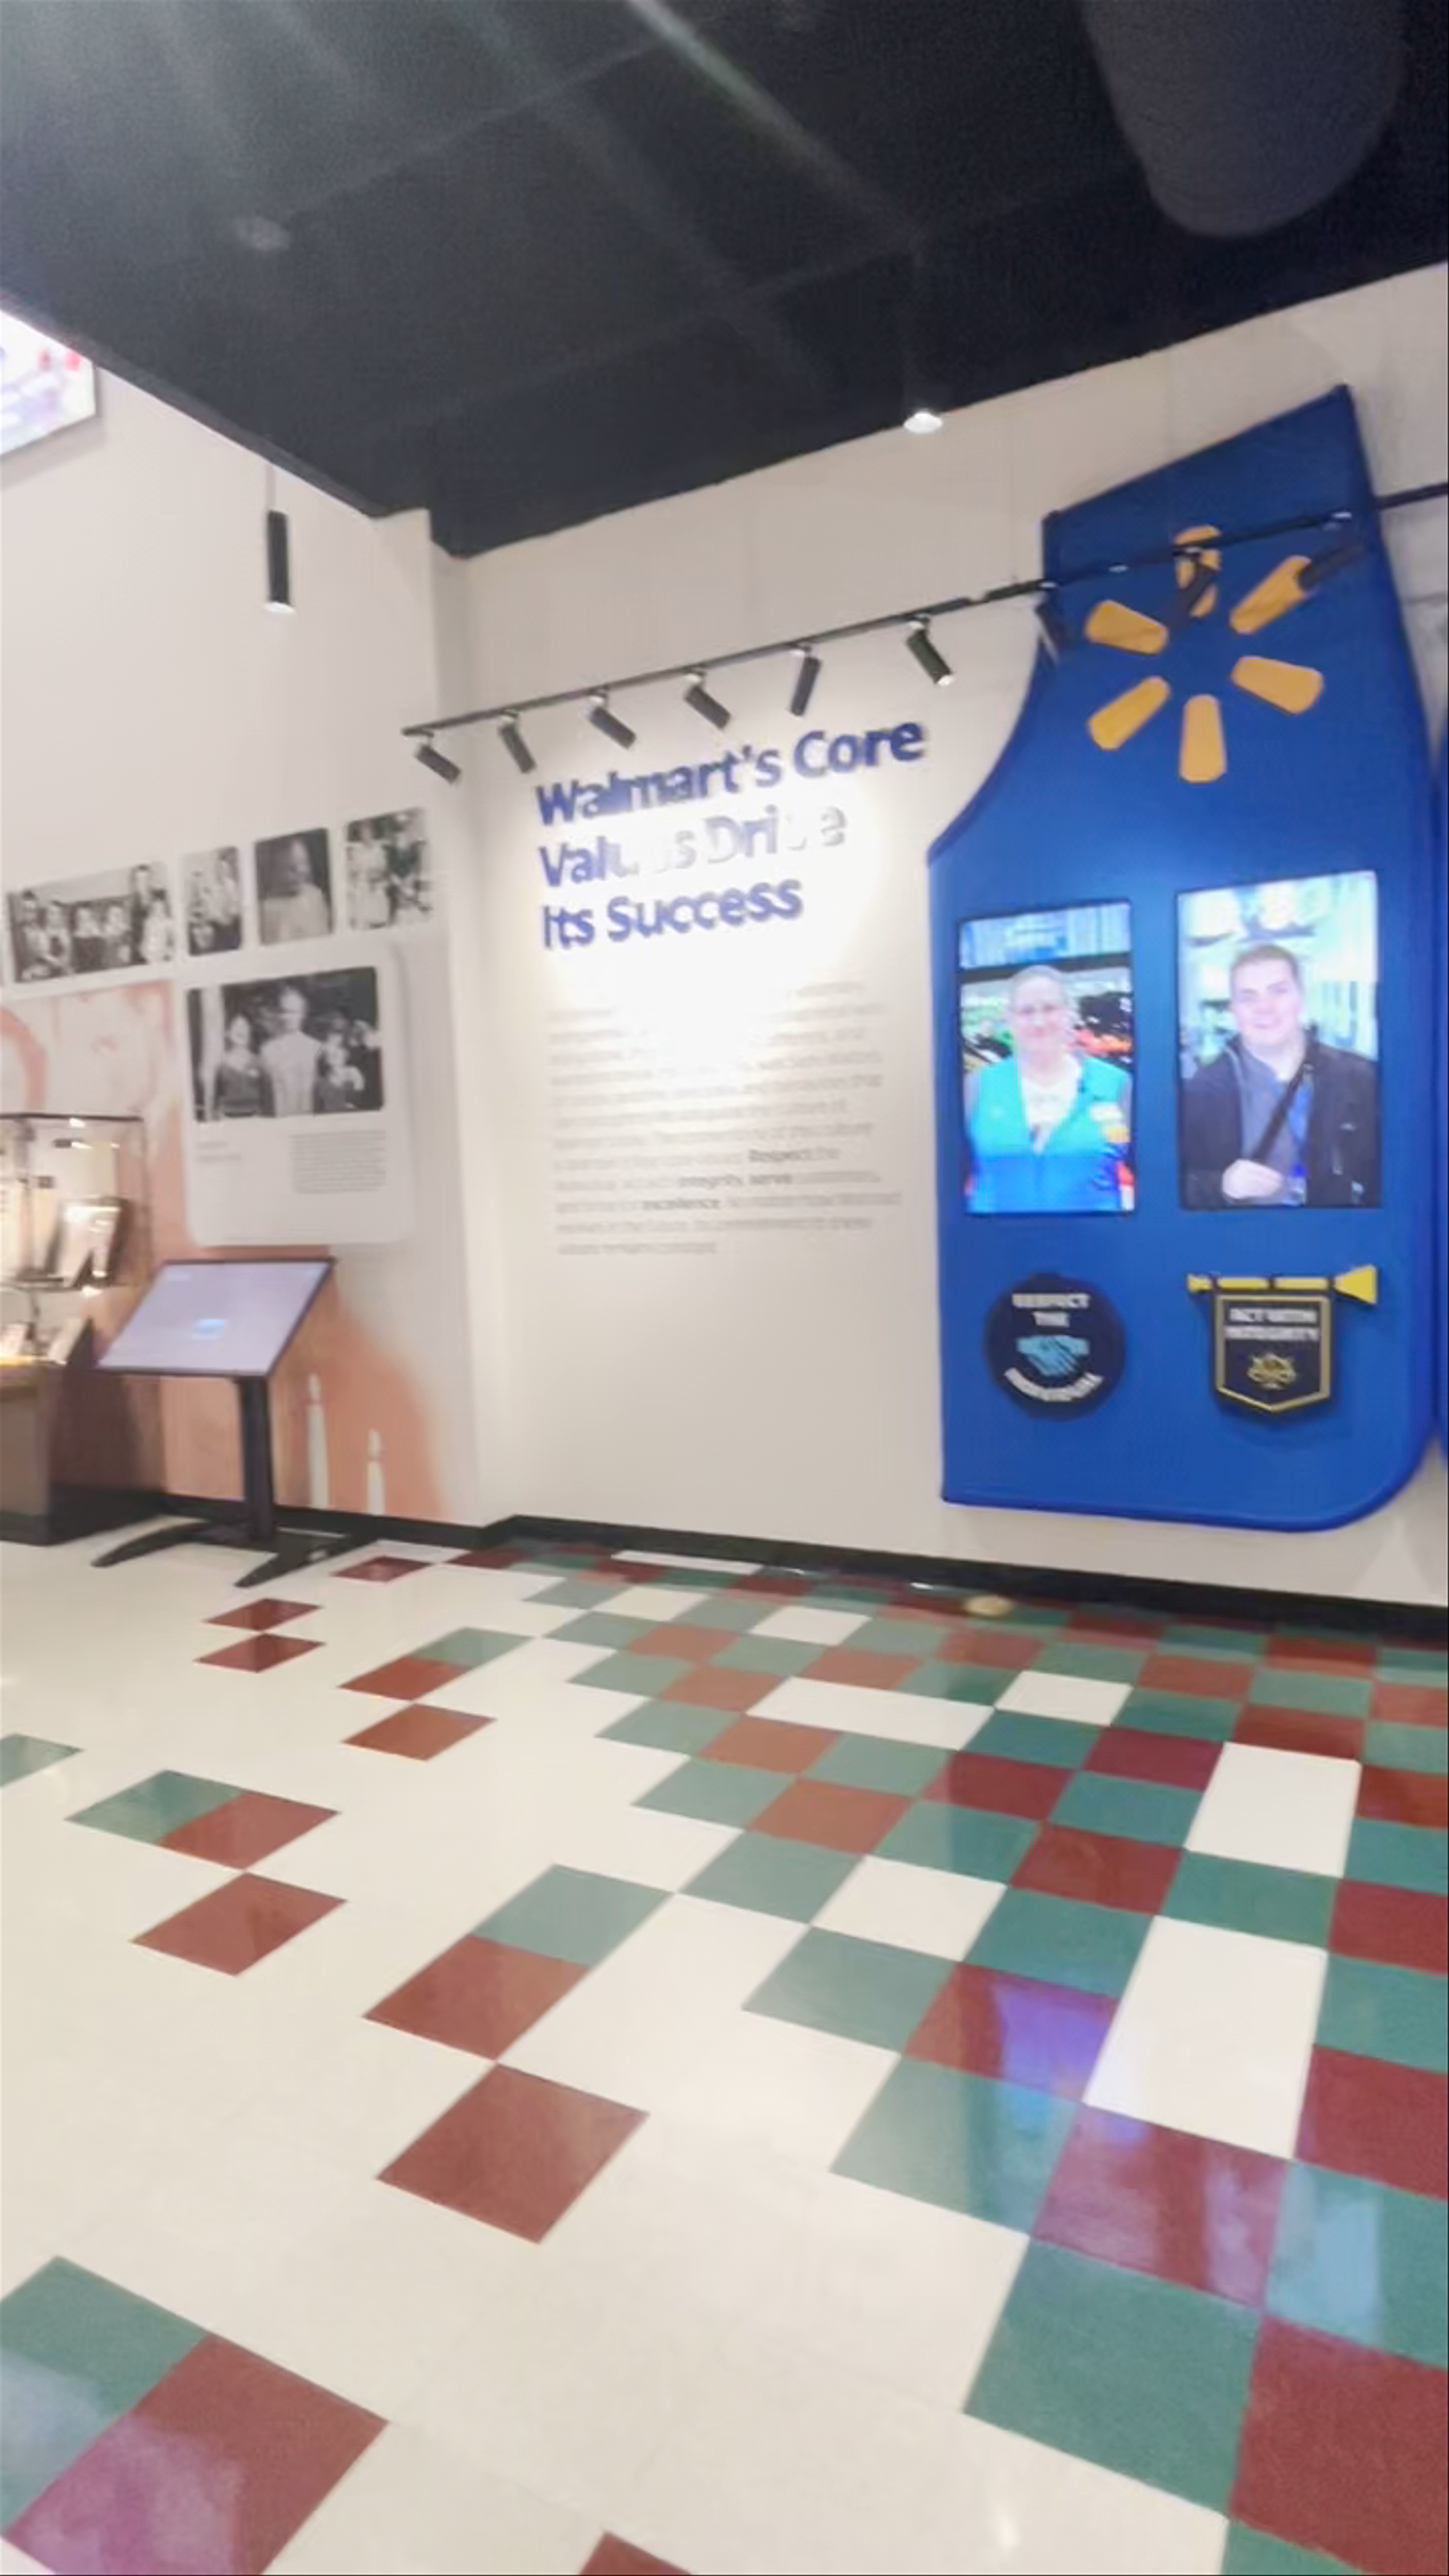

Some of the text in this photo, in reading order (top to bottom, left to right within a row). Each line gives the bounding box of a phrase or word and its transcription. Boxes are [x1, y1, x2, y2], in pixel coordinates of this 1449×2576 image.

[536, 722, 925, 826] Walmart's Core
[543, 879, 803, 949] Its Success
